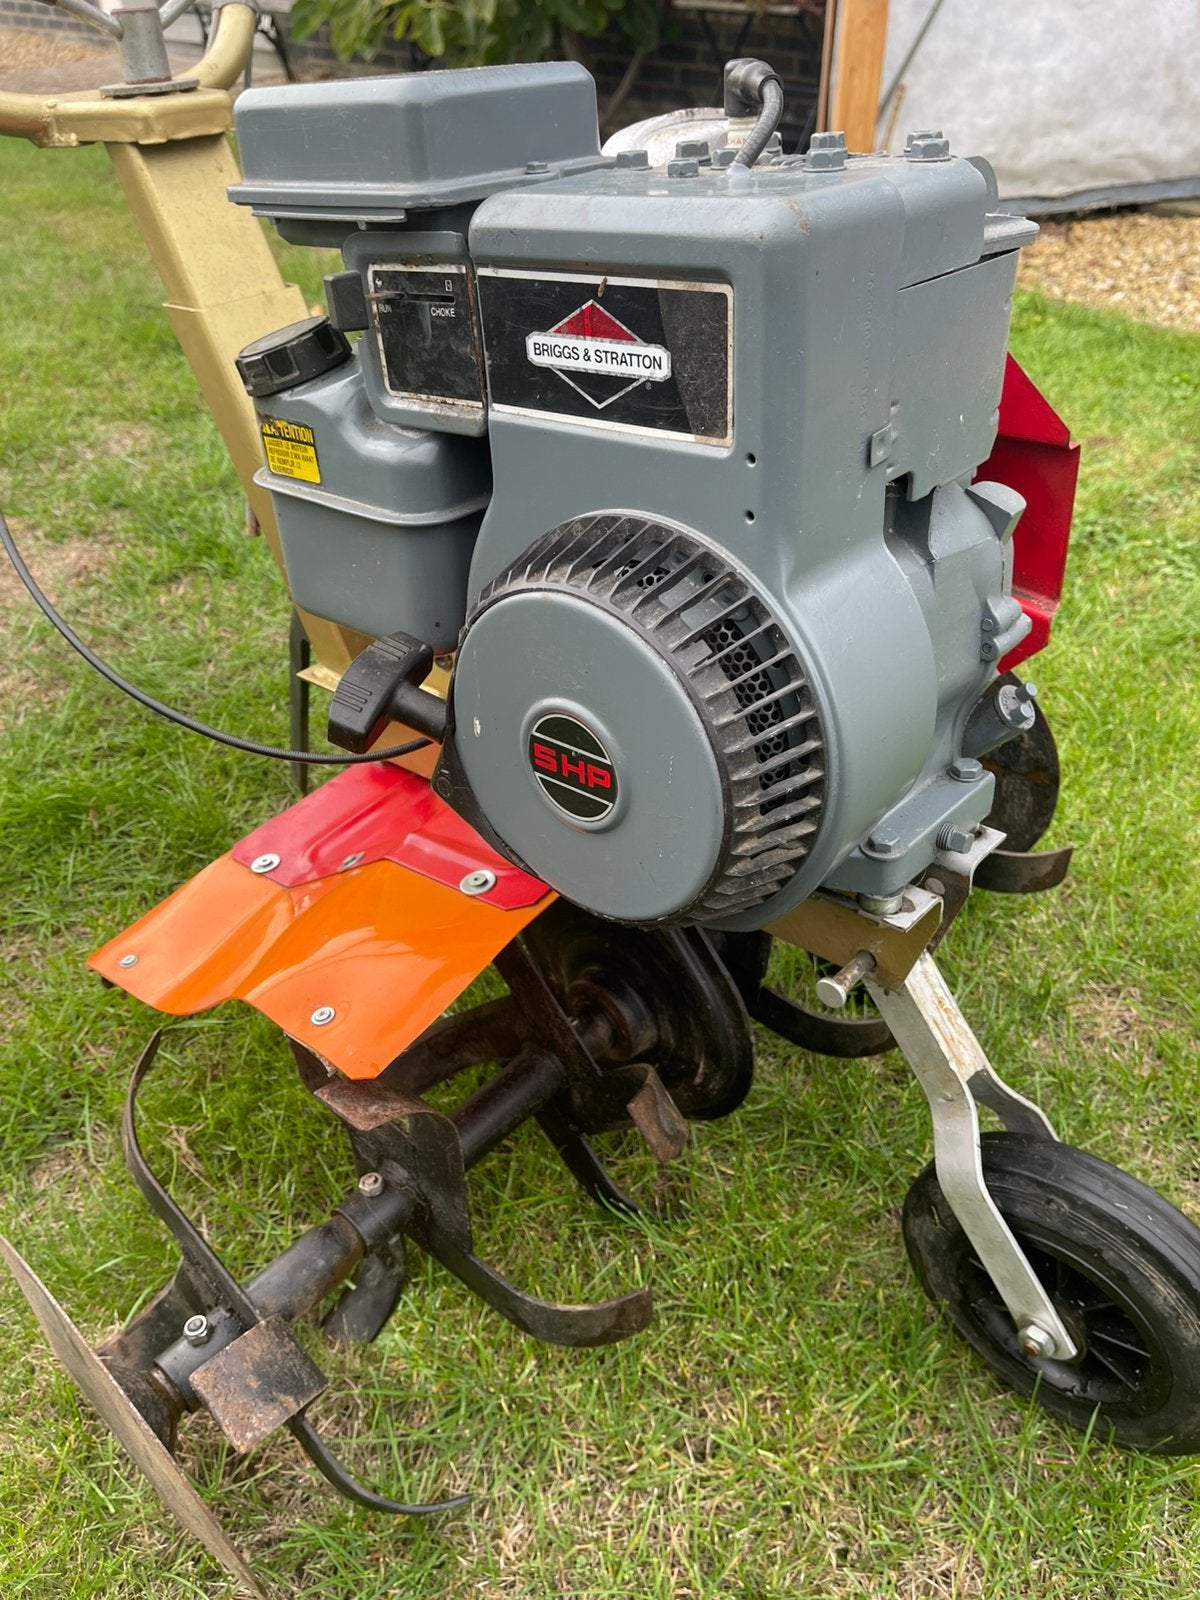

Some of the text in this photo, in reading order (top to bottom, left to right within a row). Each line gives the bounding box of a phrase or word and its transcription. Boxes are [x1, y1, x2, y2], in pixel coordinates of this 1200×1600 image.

[378, 304, 392, 313] RUN
[430, 307, 456, 318] CHOKE
[533, 342, 662, 371] BRIGGS & STRATTON
[533, 742, 611, 789] 5 HP
